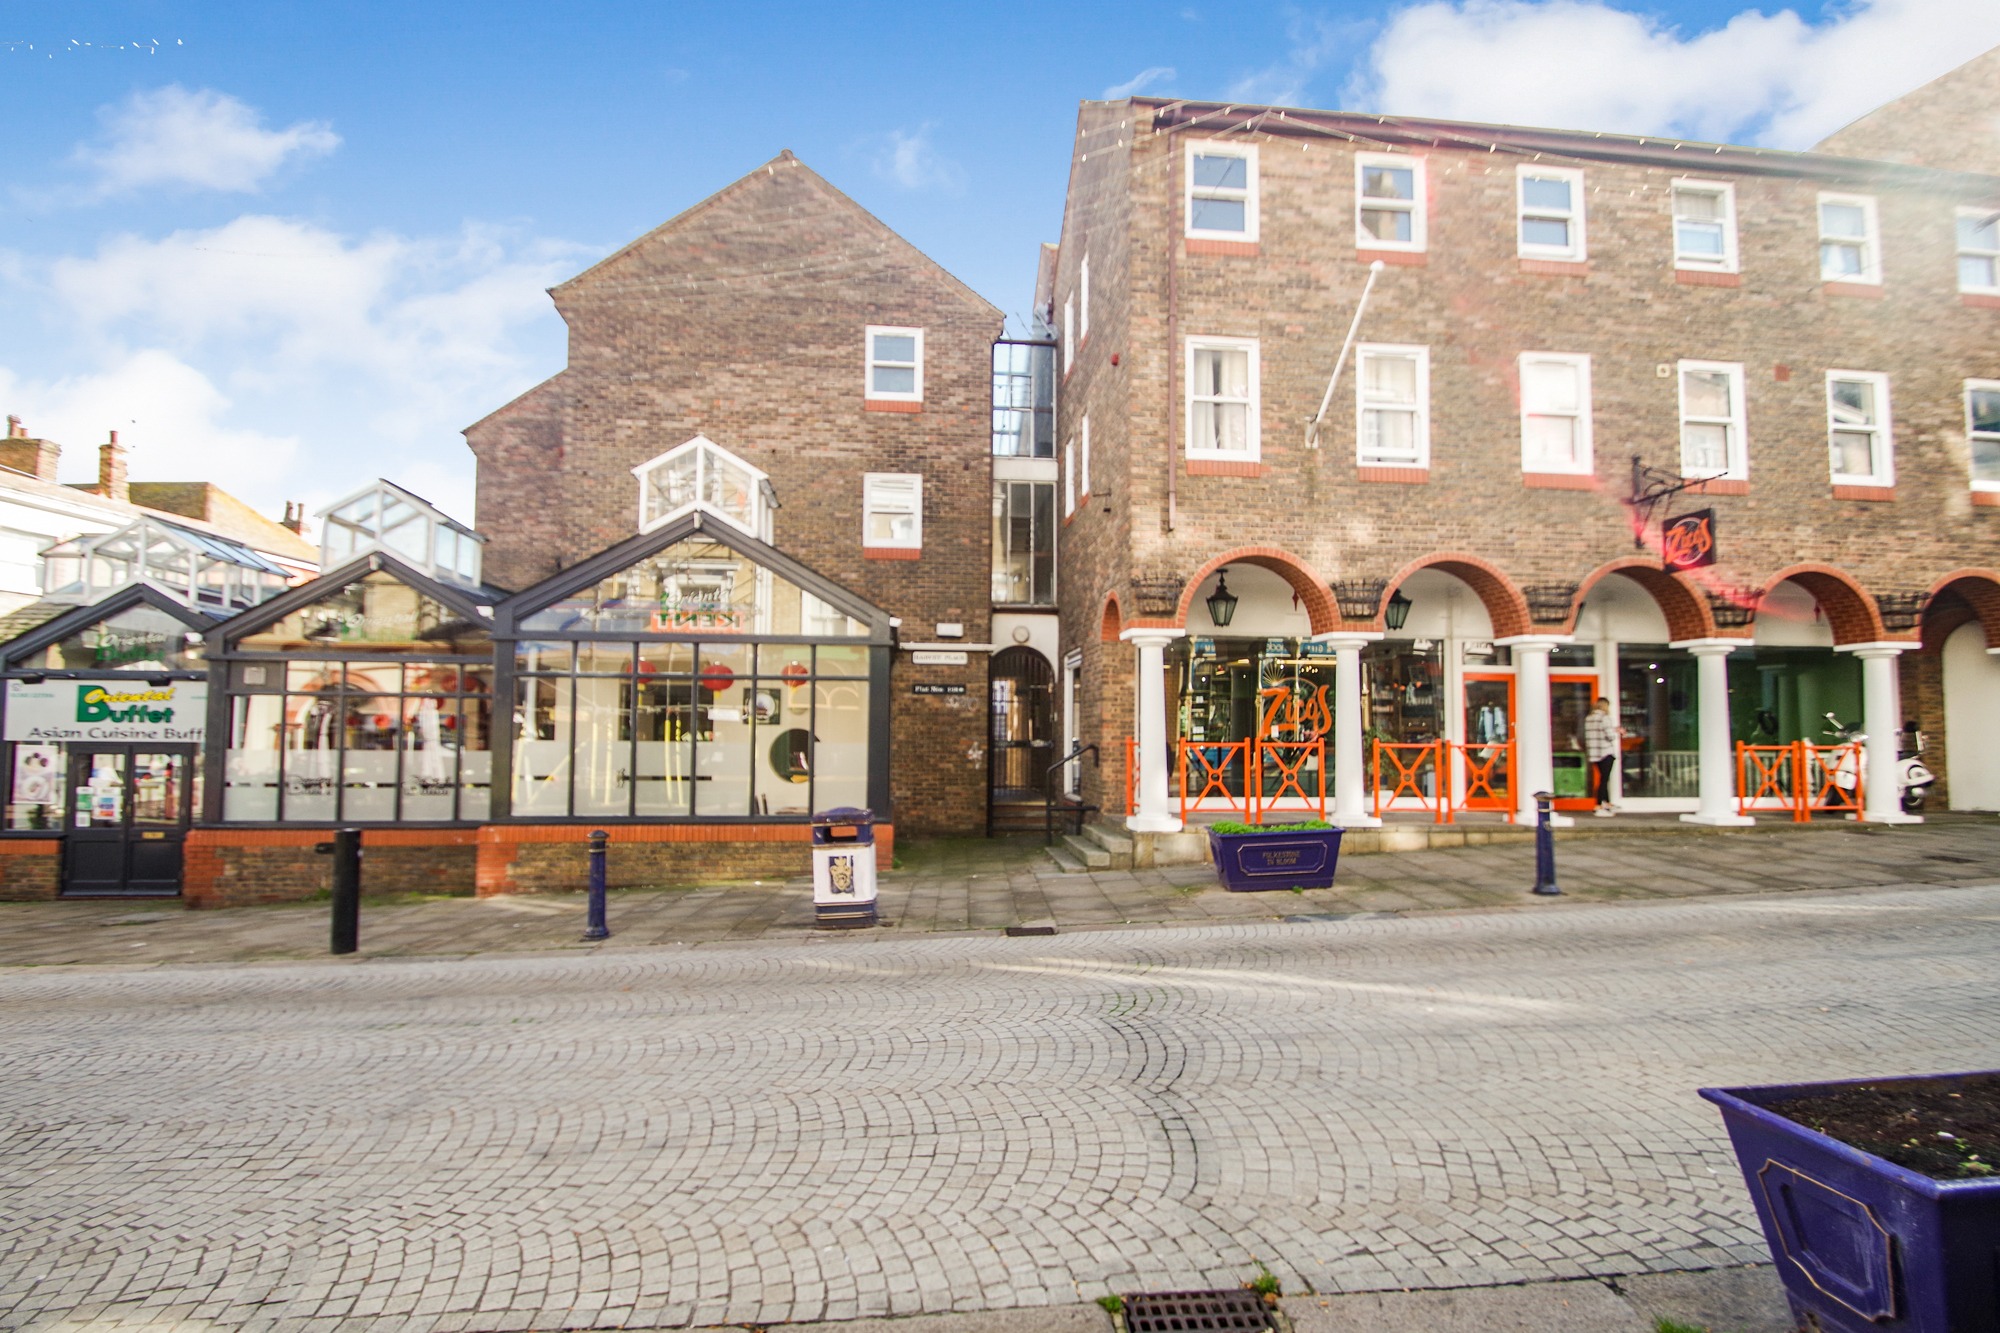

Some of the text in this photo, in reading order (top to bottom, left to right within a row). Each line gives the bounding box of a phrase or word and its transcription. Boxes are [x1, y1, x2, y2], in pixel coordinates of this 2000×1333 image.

[76, 685, 175, 723] Buffet
[84, 687, 176, 705] Oriental
[29, 726, 82, 738] Asian
[87, 727, 158, 740] Cuisine
